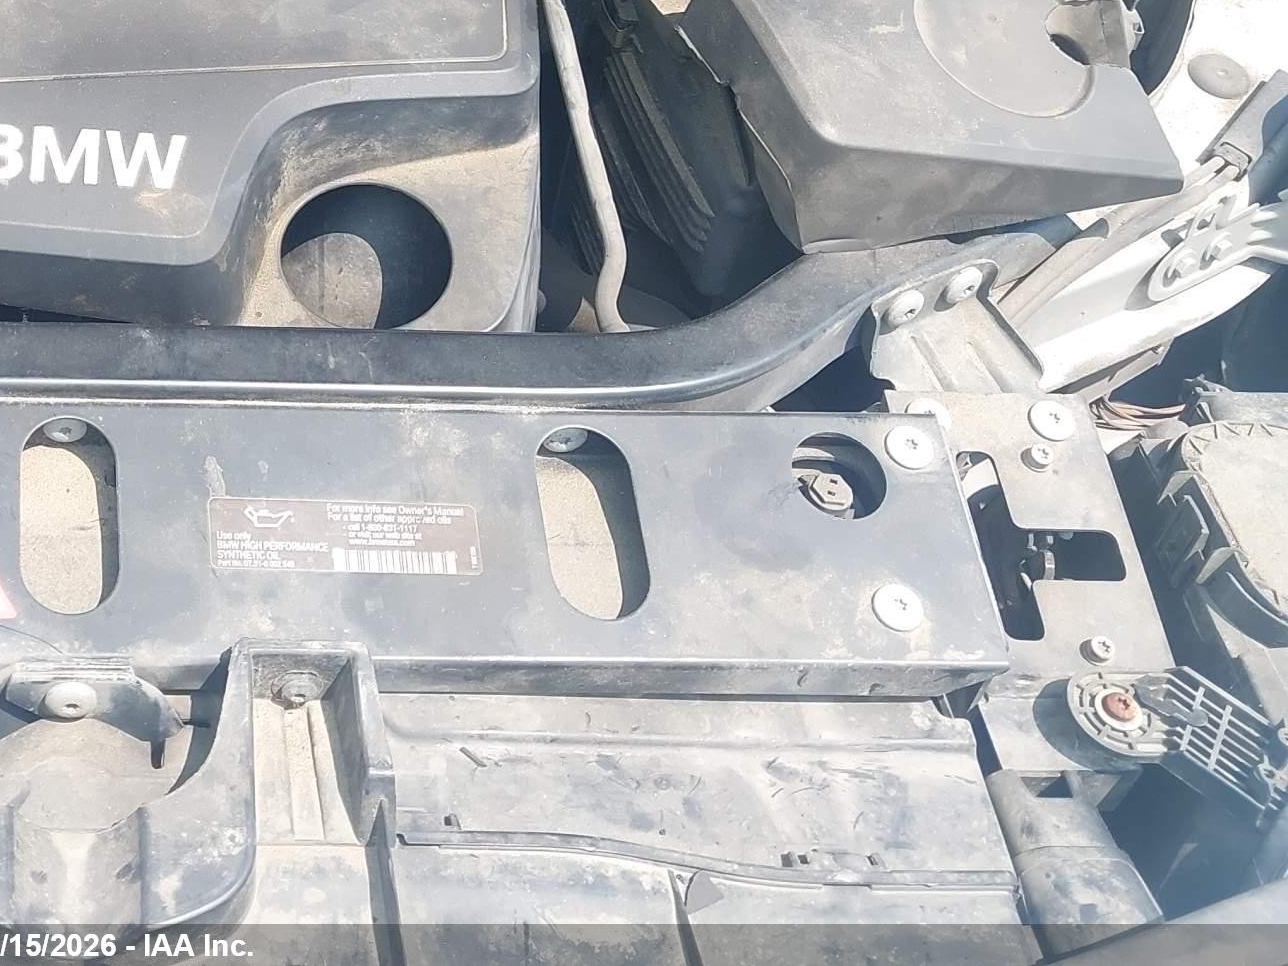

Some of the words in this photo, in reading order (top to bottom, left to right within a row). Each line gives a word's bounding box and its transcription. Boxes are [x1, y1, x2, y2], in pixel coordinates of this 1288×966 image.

[326, 502, 341, 514] For
[341, 504, 364, 516] more
[383, 506, 397, 515] see
[398, 505, 432, 516] Owner's
[433, 506, 464, 517] Manual
[327, 513, 341, 522] For
[342, 514, 349, 522] a
[363, 513, 372, 522] of
[373, 514, 395, 523] other
[216, 530, 232, 540] Use
[233, 530, 251, 543] only
[216, 540, 240, 550] BMW
[240, 540, 262, 551] HIGH
[263, 540, 329, 553] PERFORMANCE
[216, 550, 266, 560] SYNTHETIC
[266, 550, 281, 561] OIL
